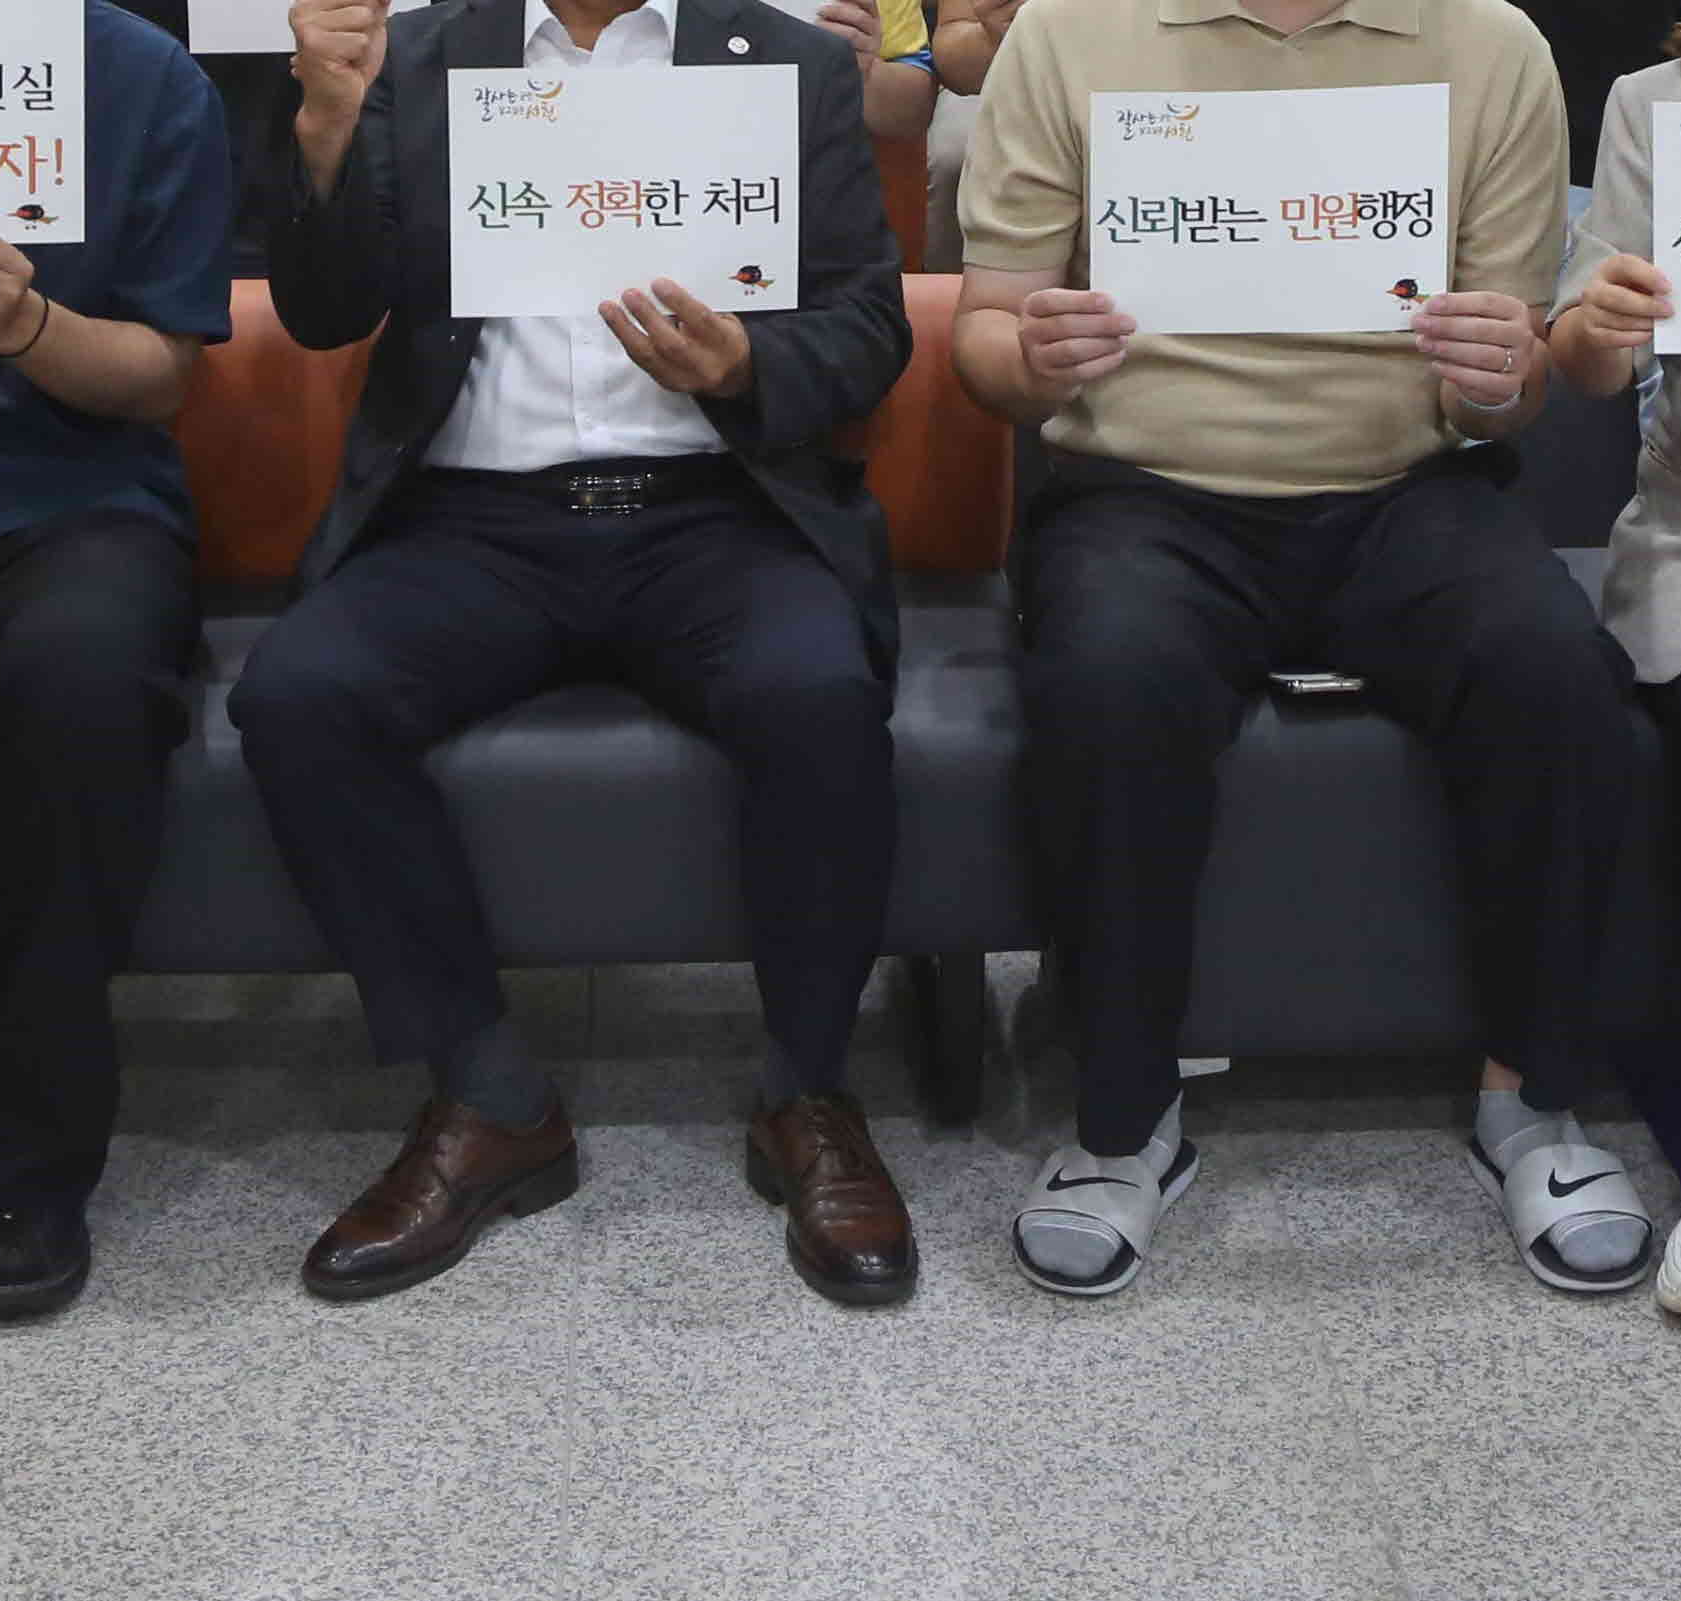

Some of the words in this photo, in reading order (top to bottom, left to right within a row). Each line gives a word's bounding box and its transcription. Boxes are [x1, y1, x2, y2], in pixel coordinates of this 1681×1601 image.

[467, 179, 553, 230] 신속
[565, 177, 690, 230] 정확한
[702, 176, 782, 226] 처리
[1095, 194, 1268, 245] 신뢰받는
[1278, 187, 1435, 242] 민원행정
